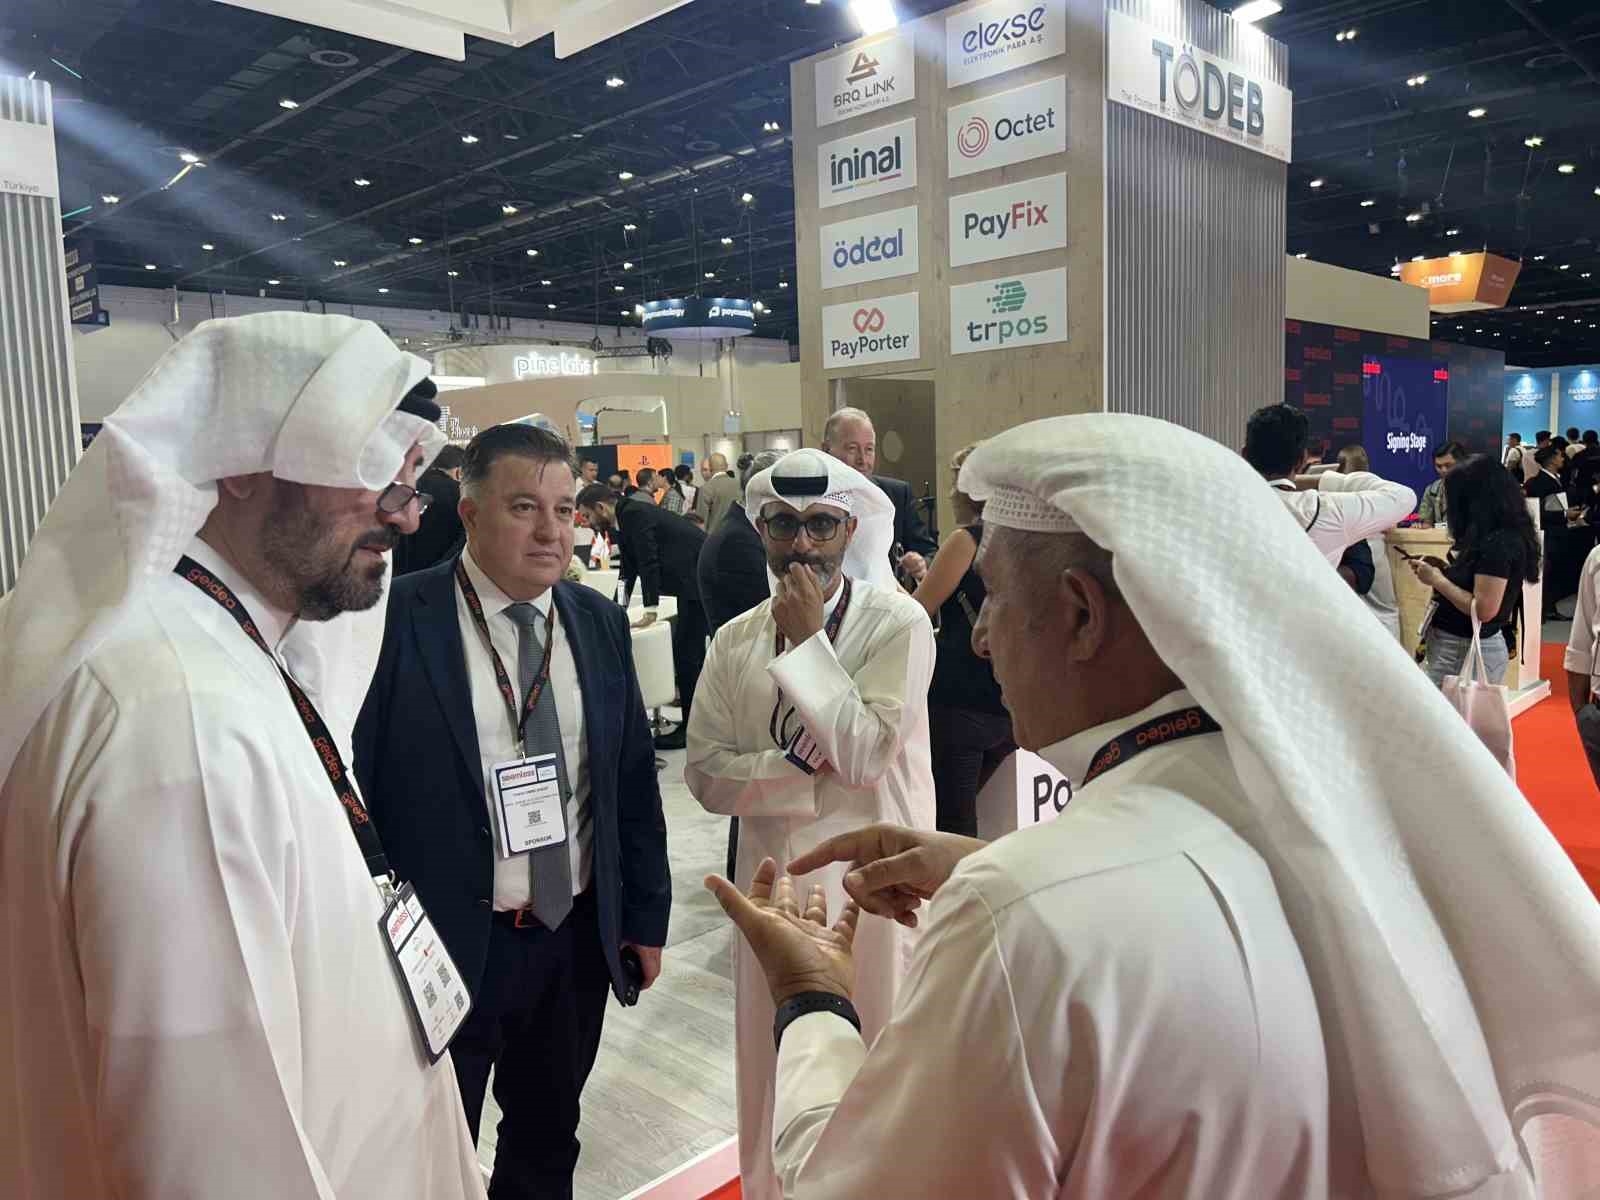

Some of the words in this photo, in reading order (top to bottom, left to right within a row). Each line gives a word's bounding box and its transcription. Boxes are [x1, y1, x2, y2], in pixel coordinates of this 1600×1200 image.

[1152, 38, 1265, 137] TÖDEB
[995, 108, 1055, 141] Octet
[831, 136, 901, 186] ininal
[965, 200, 1048, 239] PayFix
[832, 334, 909, 359] PayPorter
[967, 316, 1048, 344] trpos
[1387, 431, 1409, 454] Signing
[1410, 432, 1427, 453] Stage
